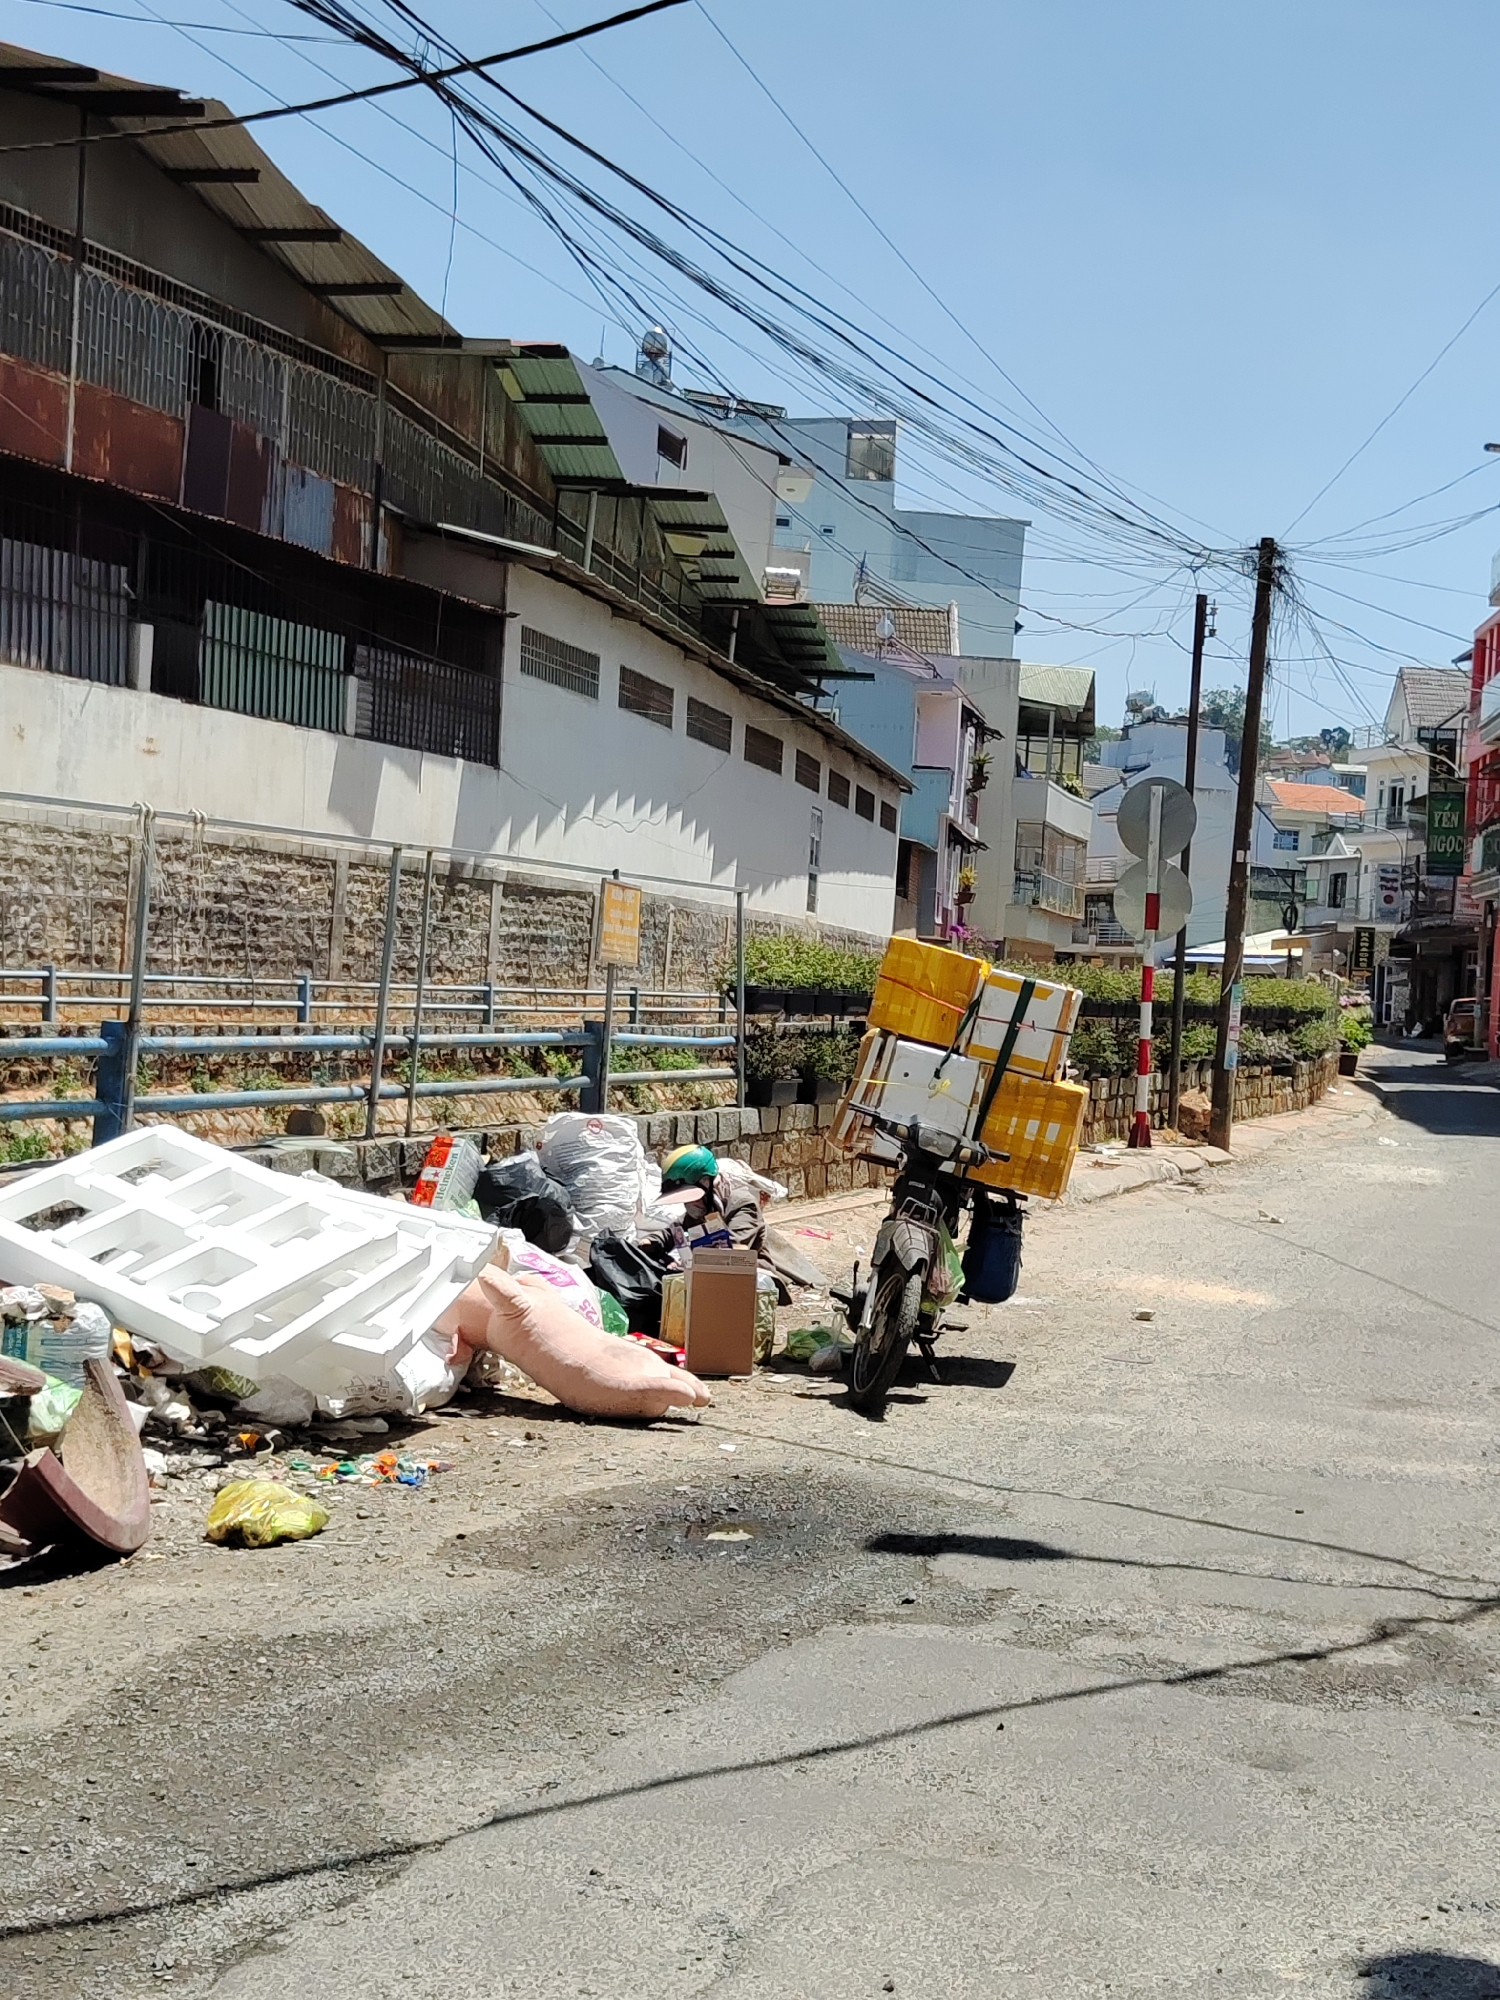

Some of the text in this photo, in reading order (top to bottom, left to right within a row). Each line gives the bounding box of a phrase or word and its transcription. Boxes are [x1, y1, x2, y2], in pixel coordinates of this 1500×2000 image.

[1433, 802, 1460, 828] YẾN
[1428, 835, 1463, 857] NGỌC
[434, 1152, 459, 1200] Heineken
